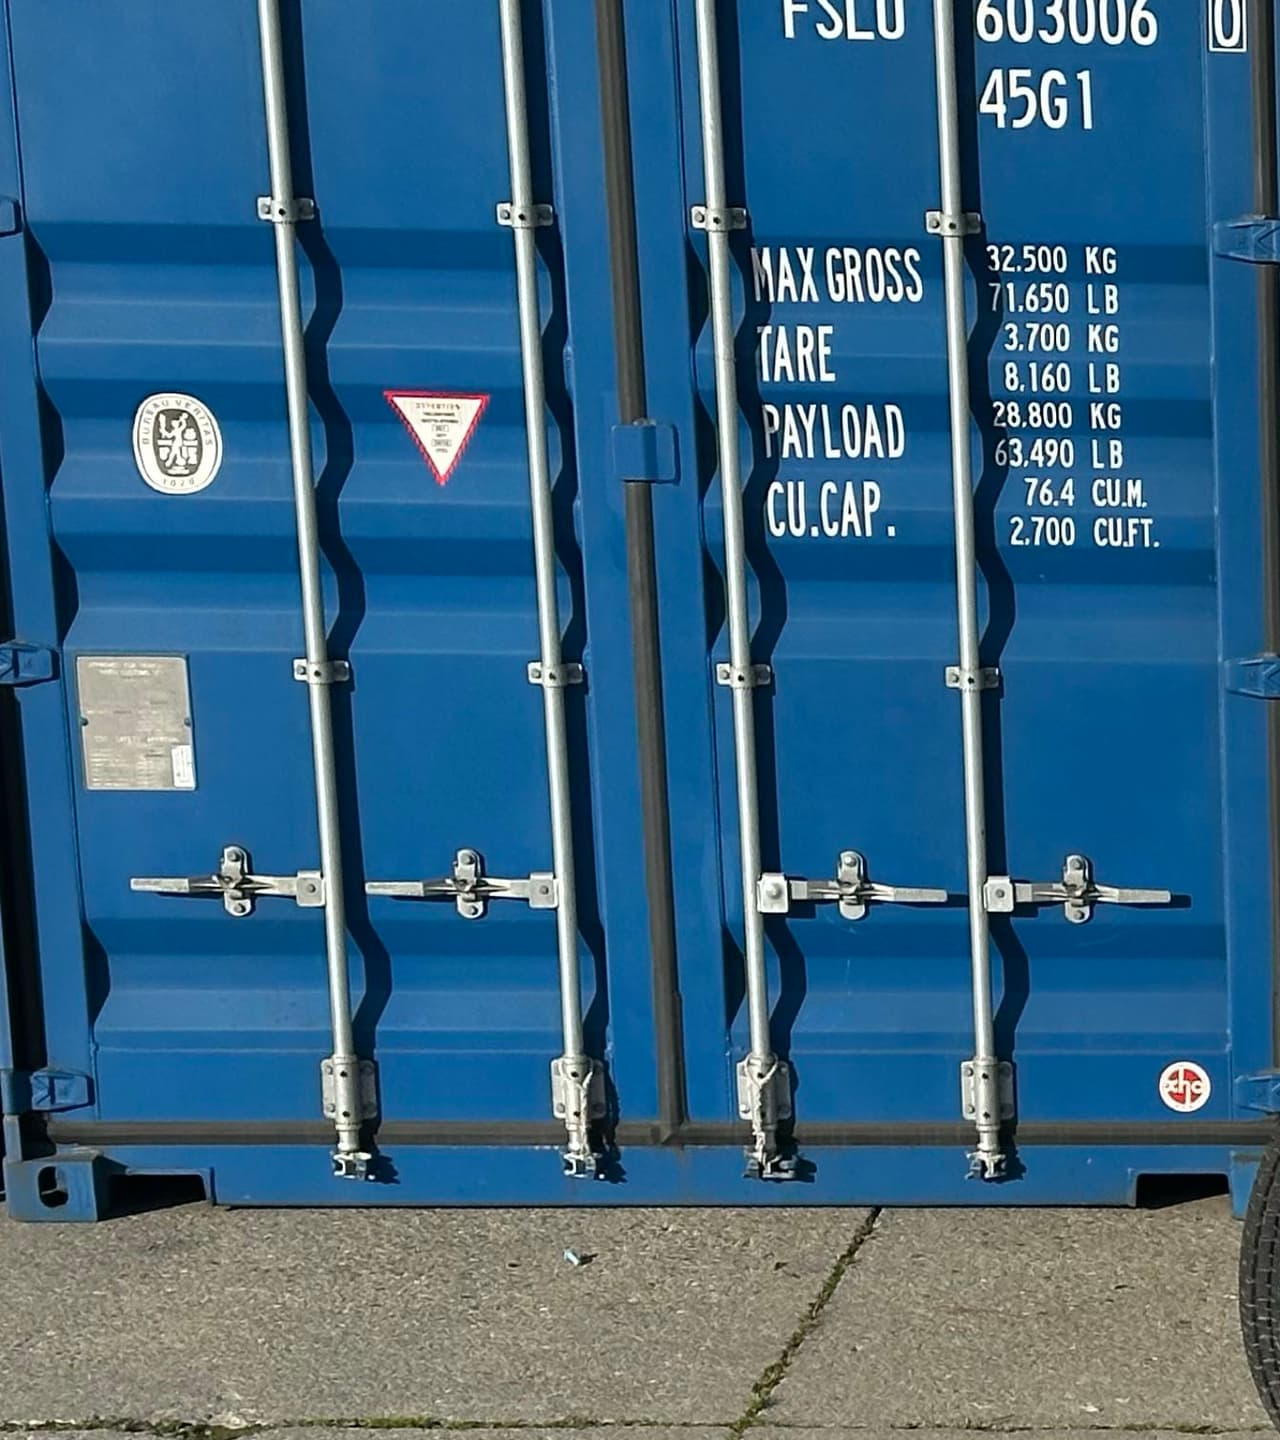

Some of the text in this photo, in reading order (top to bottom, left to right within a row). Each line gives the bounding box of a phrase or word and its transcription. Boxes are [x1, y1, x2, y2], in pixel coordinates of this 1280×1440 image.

[784, 0, 905, 40] FSLU
[976, 0, 1158, 45] 603006
[979, 69, 1093, 129] 45G1
[1085, 246, 1117, 273] KG
[751, 247, 924, 303] MAX GROSS
[1087, 284, 1119, 314] LB
[1088, 324, 1120, 352] KG
[756, 325, 836, 382] TARE
[1088, 362, 1120, 393] LB
[762, 404, 905, 458] PAYLOAD
[1090, 403, 1121, 429] KG
[1092, 439, 1123, 469] LB
[1024, 478, 1148, 508] 76.4 CU.M.
[1094, 518, 1160, 547] CU.FT.
